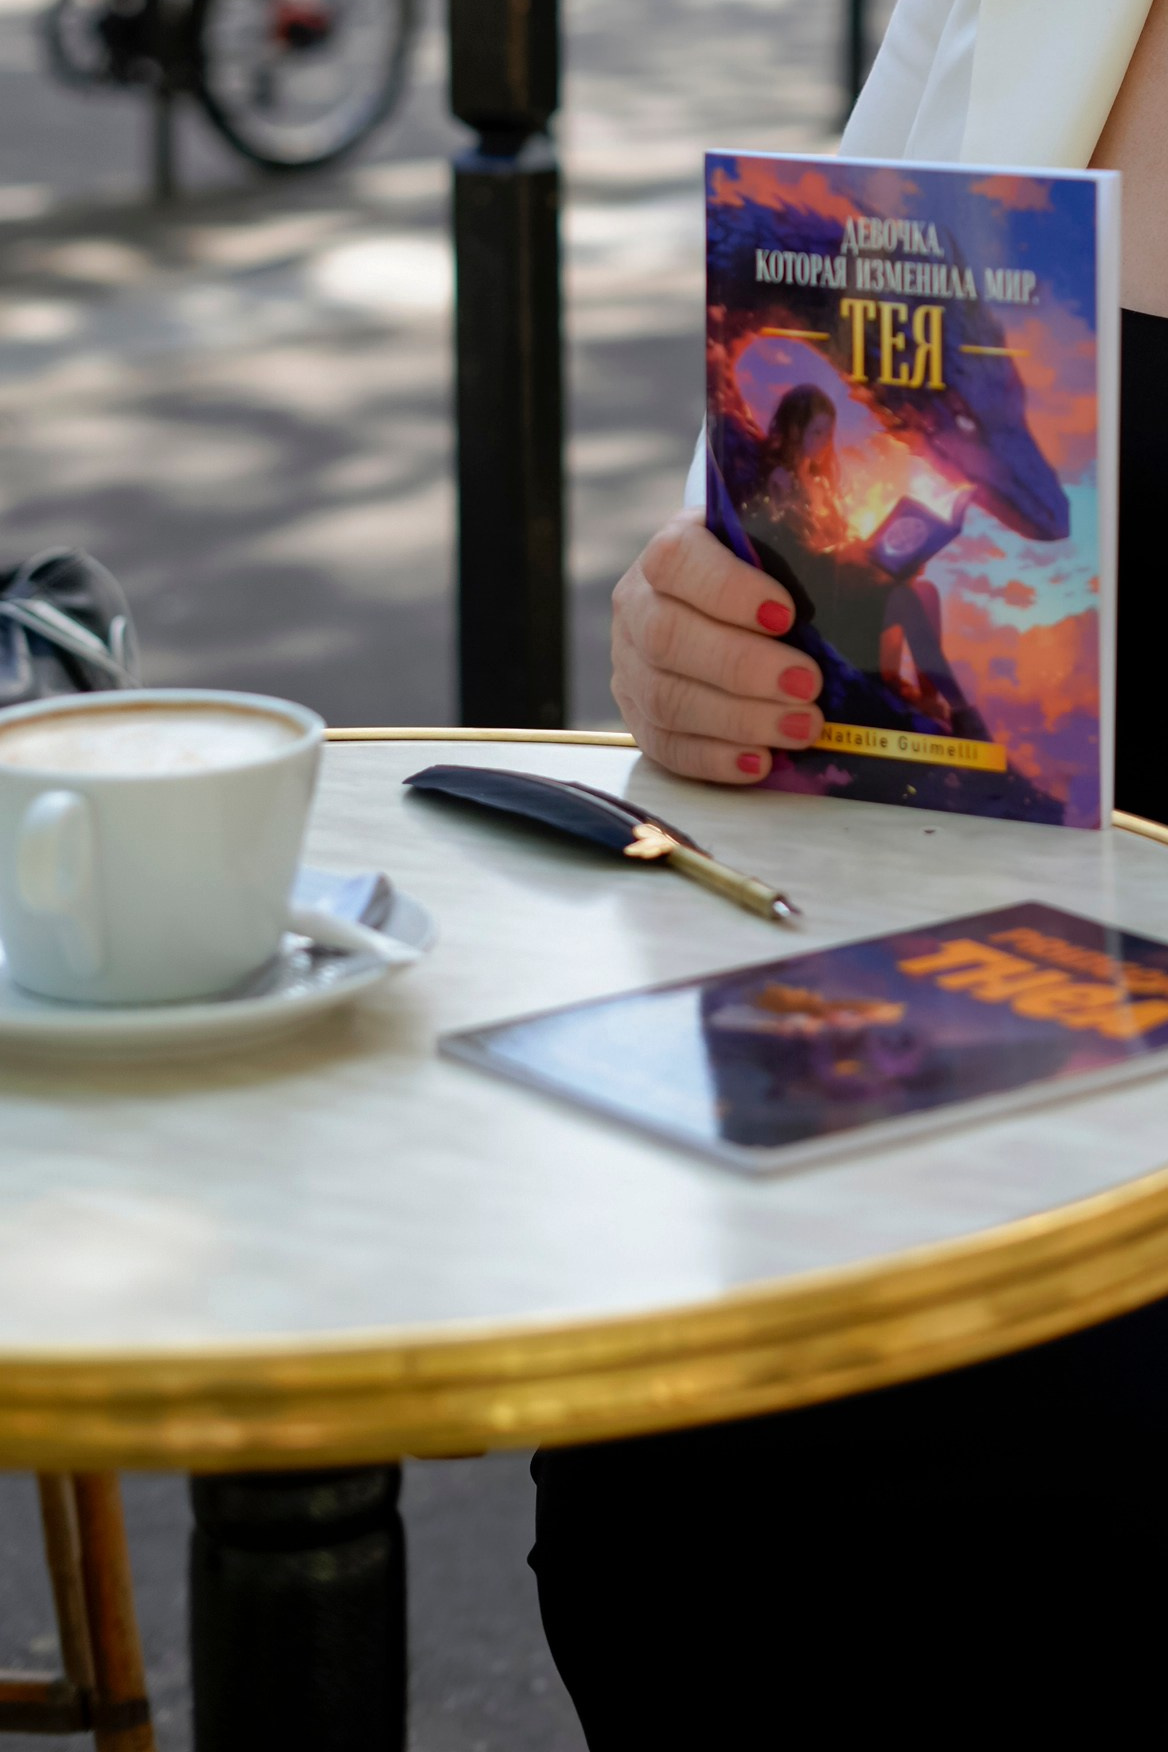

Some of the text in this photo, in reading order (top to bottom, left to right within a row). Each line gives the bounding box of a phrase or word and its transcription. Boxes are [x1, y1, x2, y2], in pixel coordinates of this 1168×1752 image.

[755, 248, 1040, 305] КОТОРАЯ ИЗМЕНИЛА МИР.
[840, 298, 947, 392] ТЕЯ
[821, 725, 888, 748] Natalie
